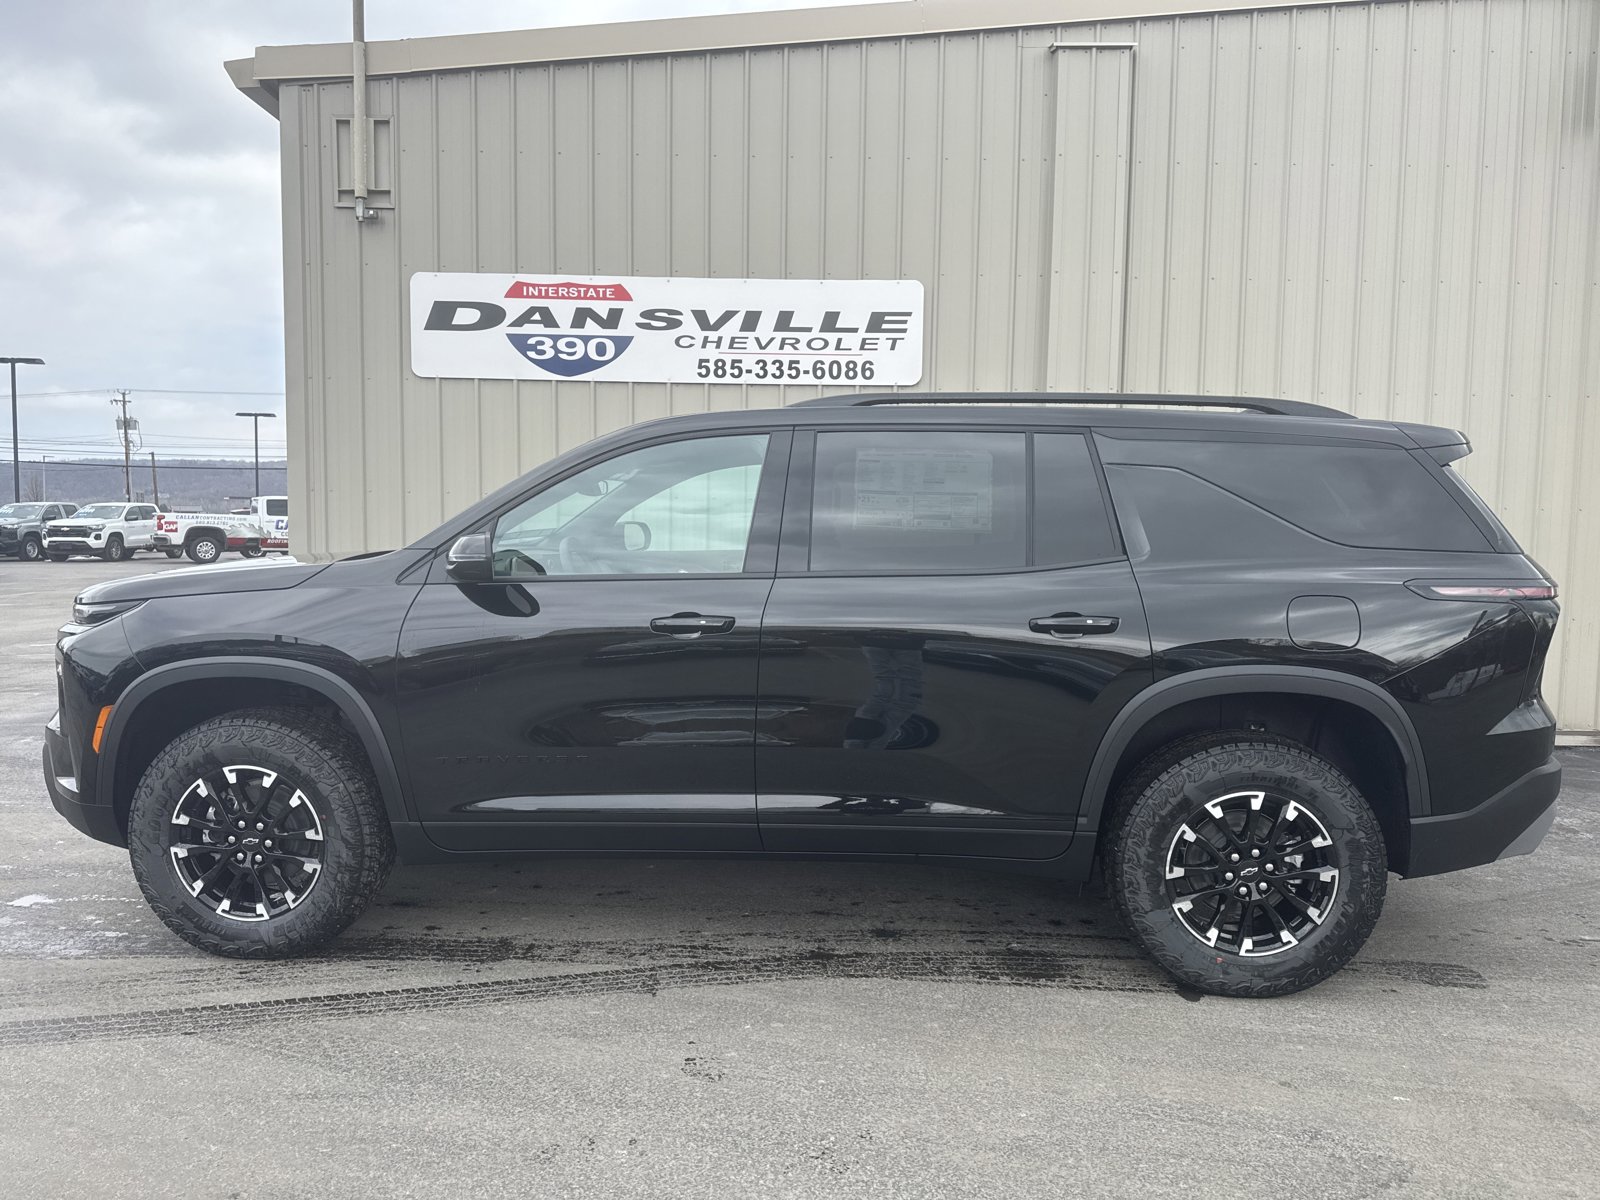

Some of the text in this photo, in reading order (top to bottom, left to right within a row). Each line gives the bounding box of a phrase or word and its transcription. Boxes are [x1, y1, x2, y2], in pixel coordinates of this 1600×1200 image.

[522, 285, 615, 298] INTERSTATE
[423, 300, 913, 334] DANSVILLE
[526, 336, 616, 361] 390
[674, 335, 905, 351] CHEVROLET
[696, 358, 875, 381] 585-335-6086
